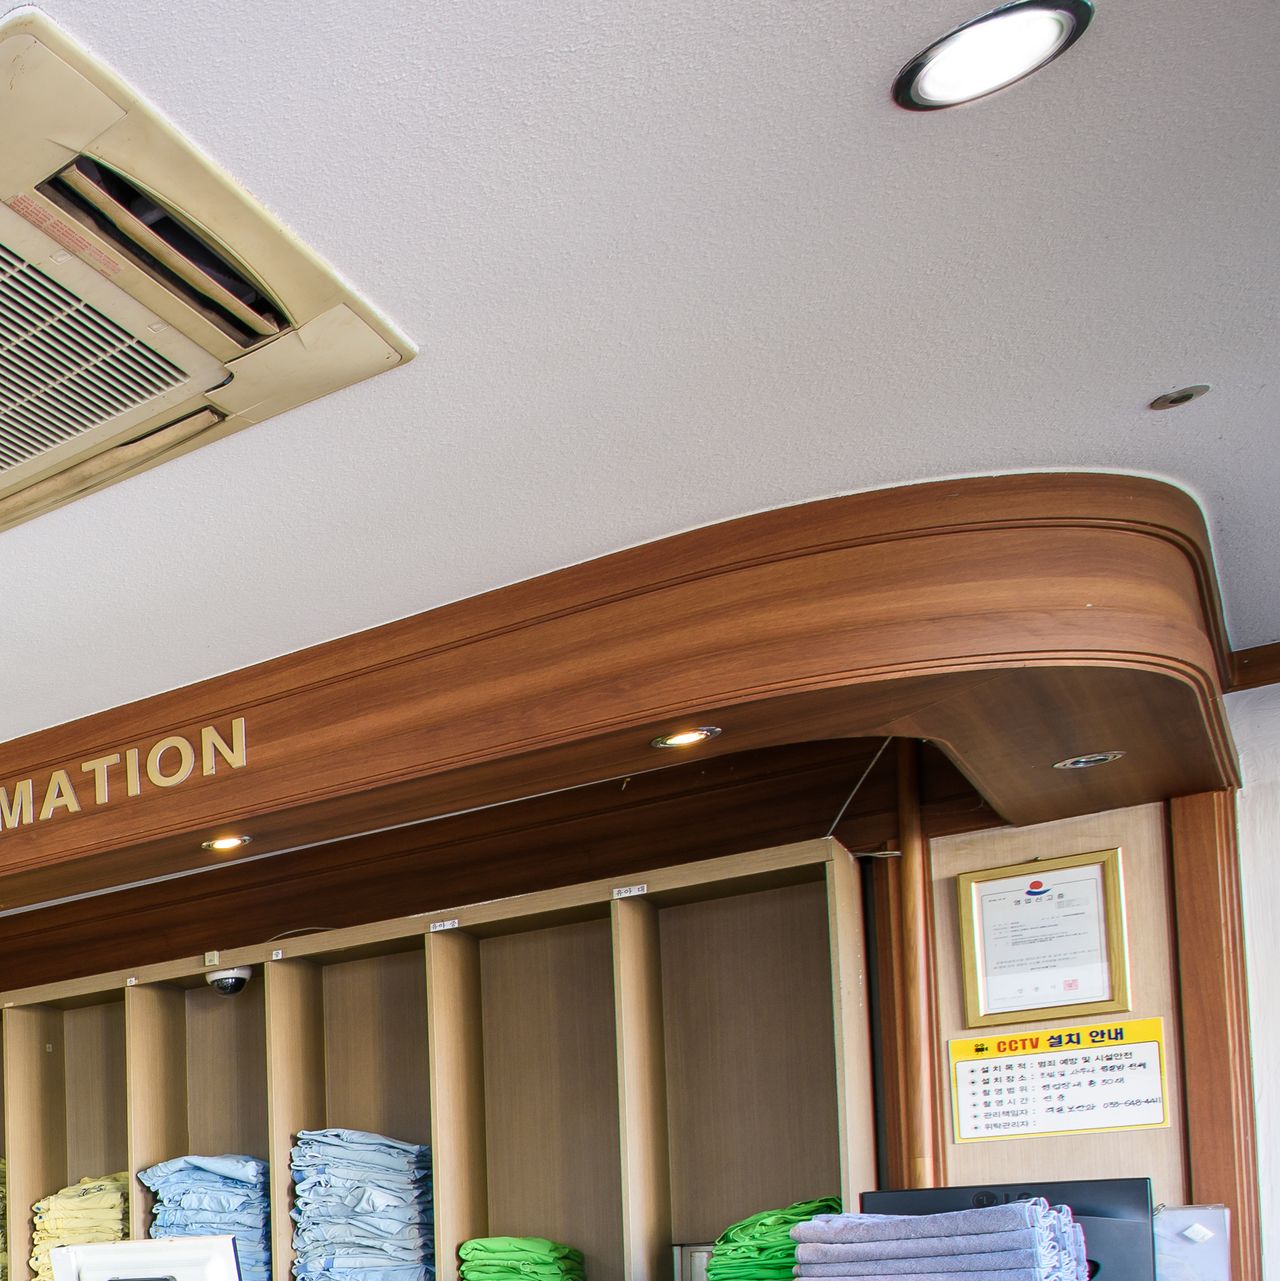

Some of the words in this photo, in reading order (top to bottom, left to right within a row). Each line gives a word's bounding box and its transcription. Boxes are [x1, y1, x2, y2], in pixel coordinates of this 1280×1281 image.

[997, 1037, 1040, 1053] CCTV
[1047, 1032, 1081, 1048] 설치
[1089, 1027, 1124, 1042] 안내
[1095, 1052, 1133, 1062] 시설안전
